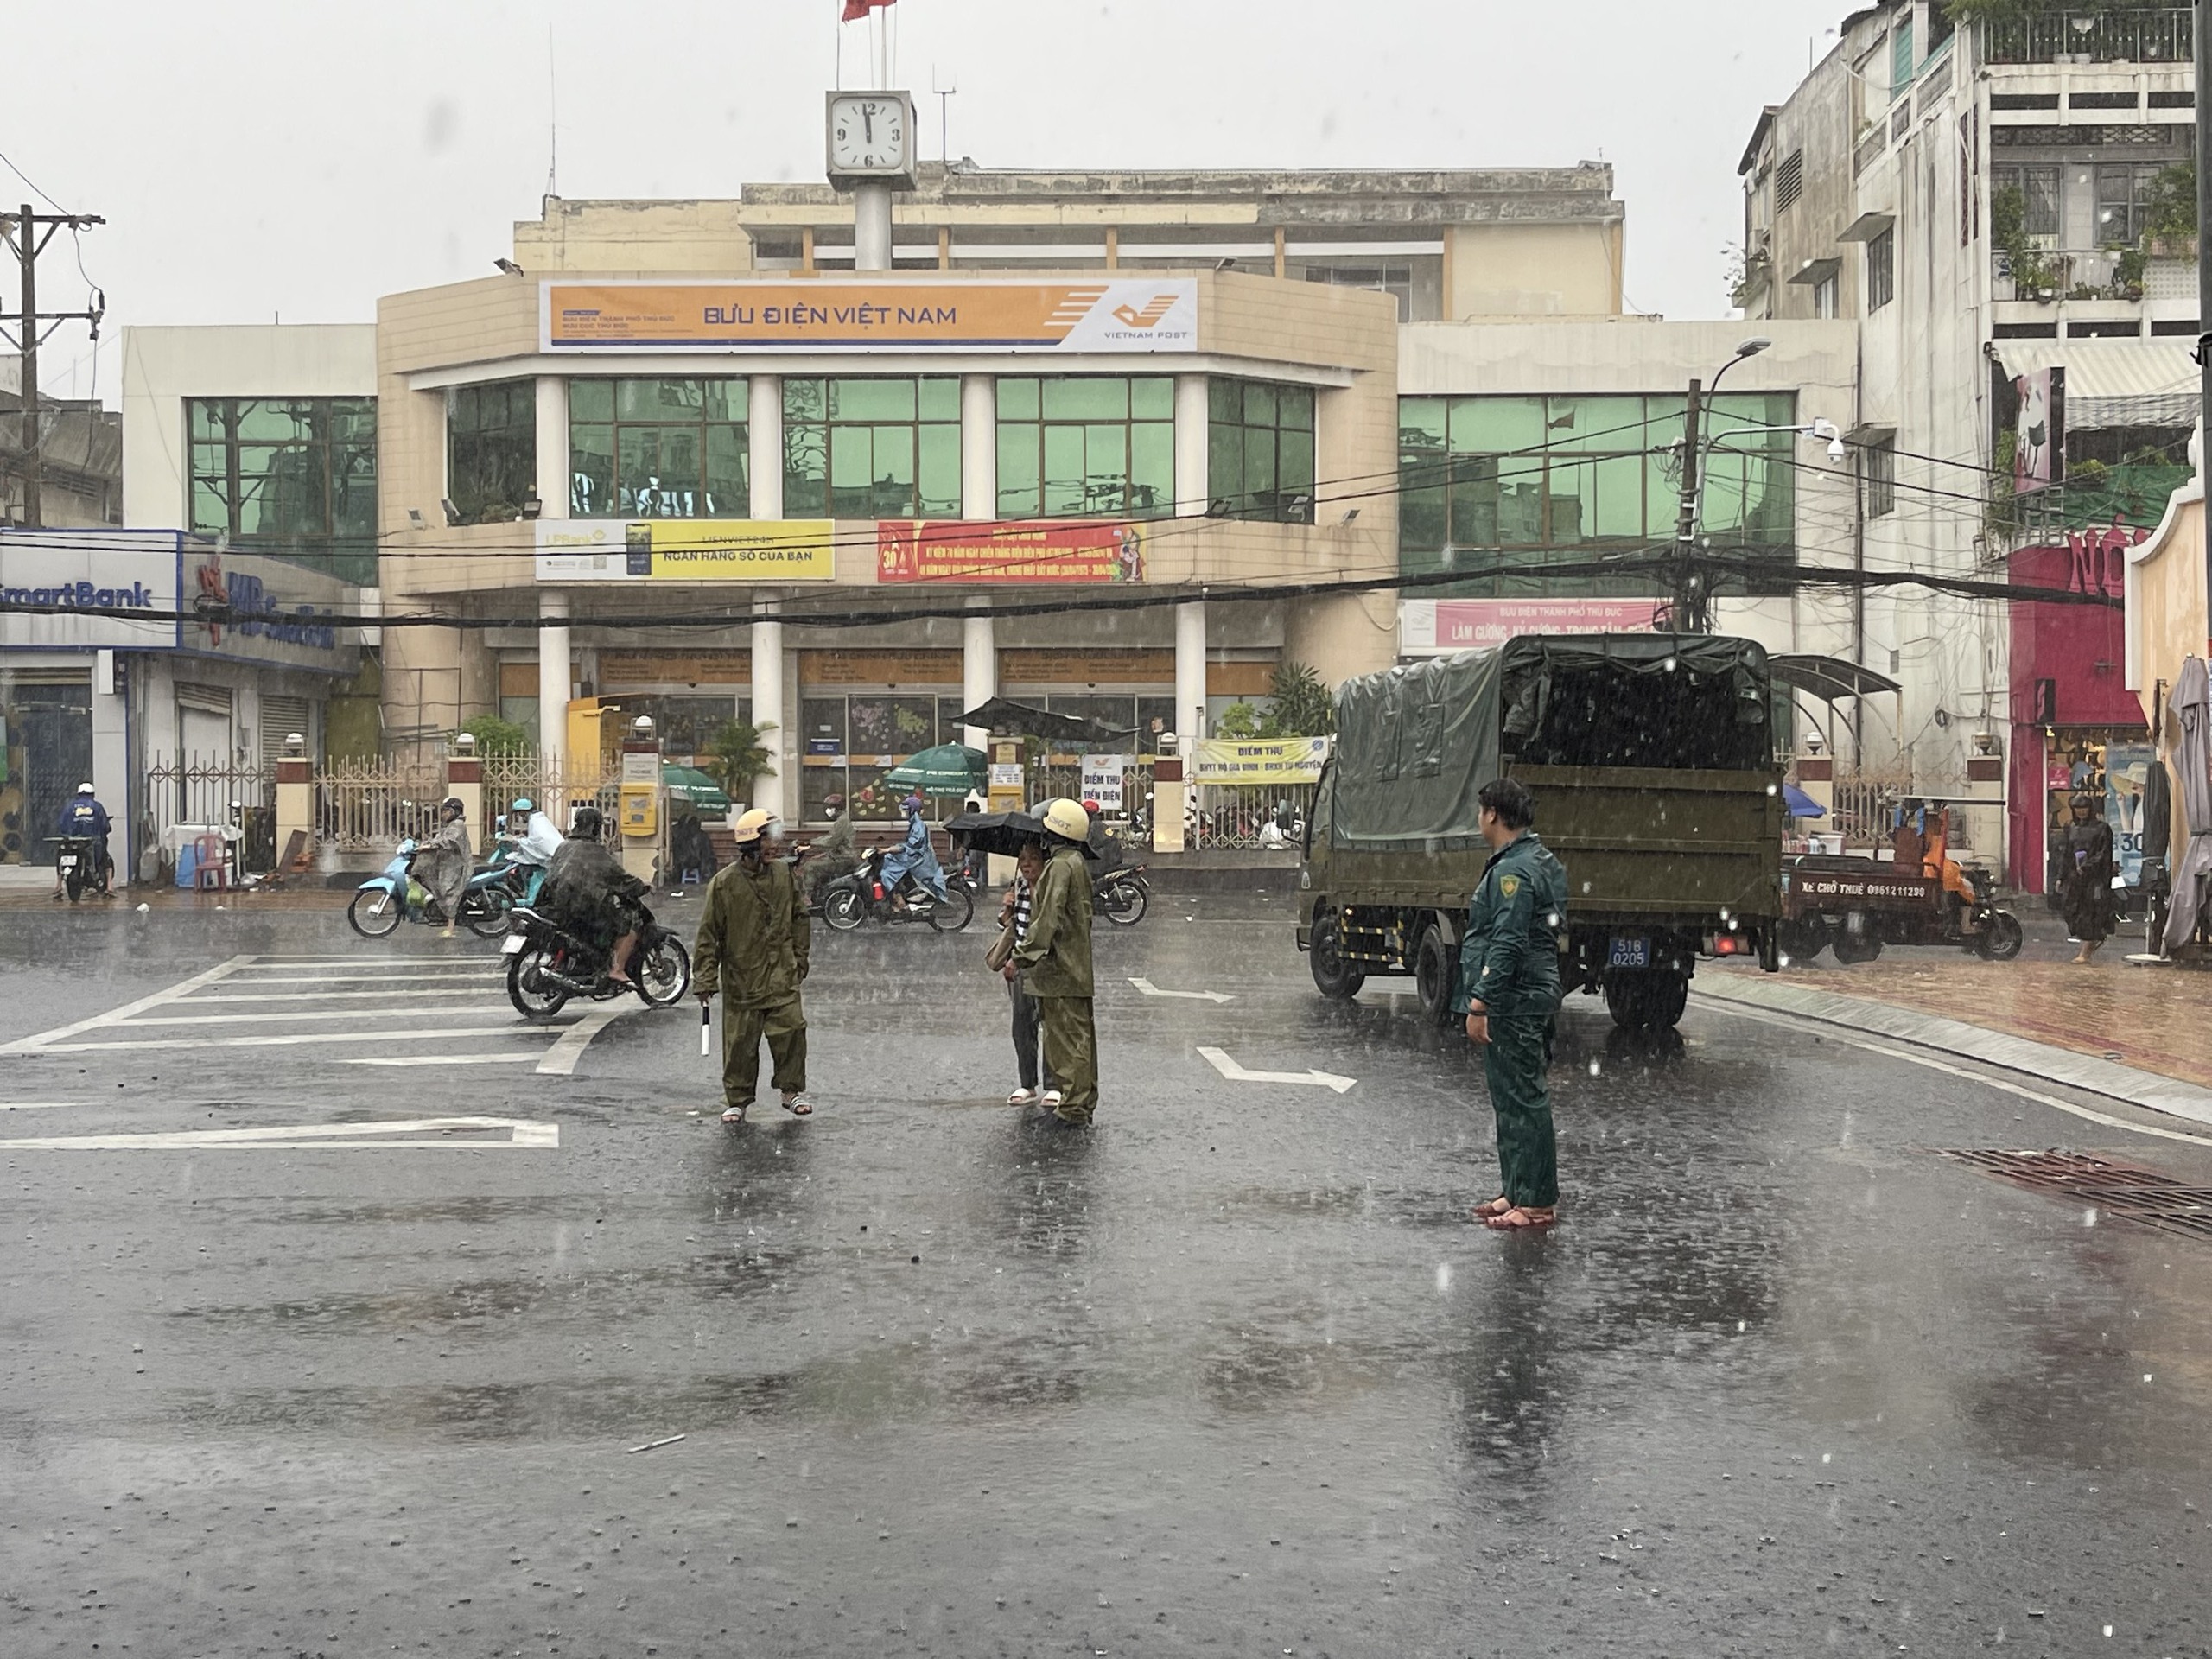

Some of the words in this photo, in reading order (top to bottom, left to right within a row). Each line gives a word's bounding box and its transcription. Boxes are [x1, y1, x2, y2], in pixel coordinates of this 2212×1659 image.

[837, 129, 846, 141] 9
[892, 129, 900, 142] 3
[864, 154, 874, 168] 6
[704, 303, 753, 324] BƯU
[763, 302, 827, 329] ĐIỆN
[833, 302, 891, 330] VIỆT
[898, 308, 956, 325] NAM
[1106, 775, 1121, 785] THU
[1618, 939, 1642, 952] 51B
[1613, 952, 1644, 965] 0205
